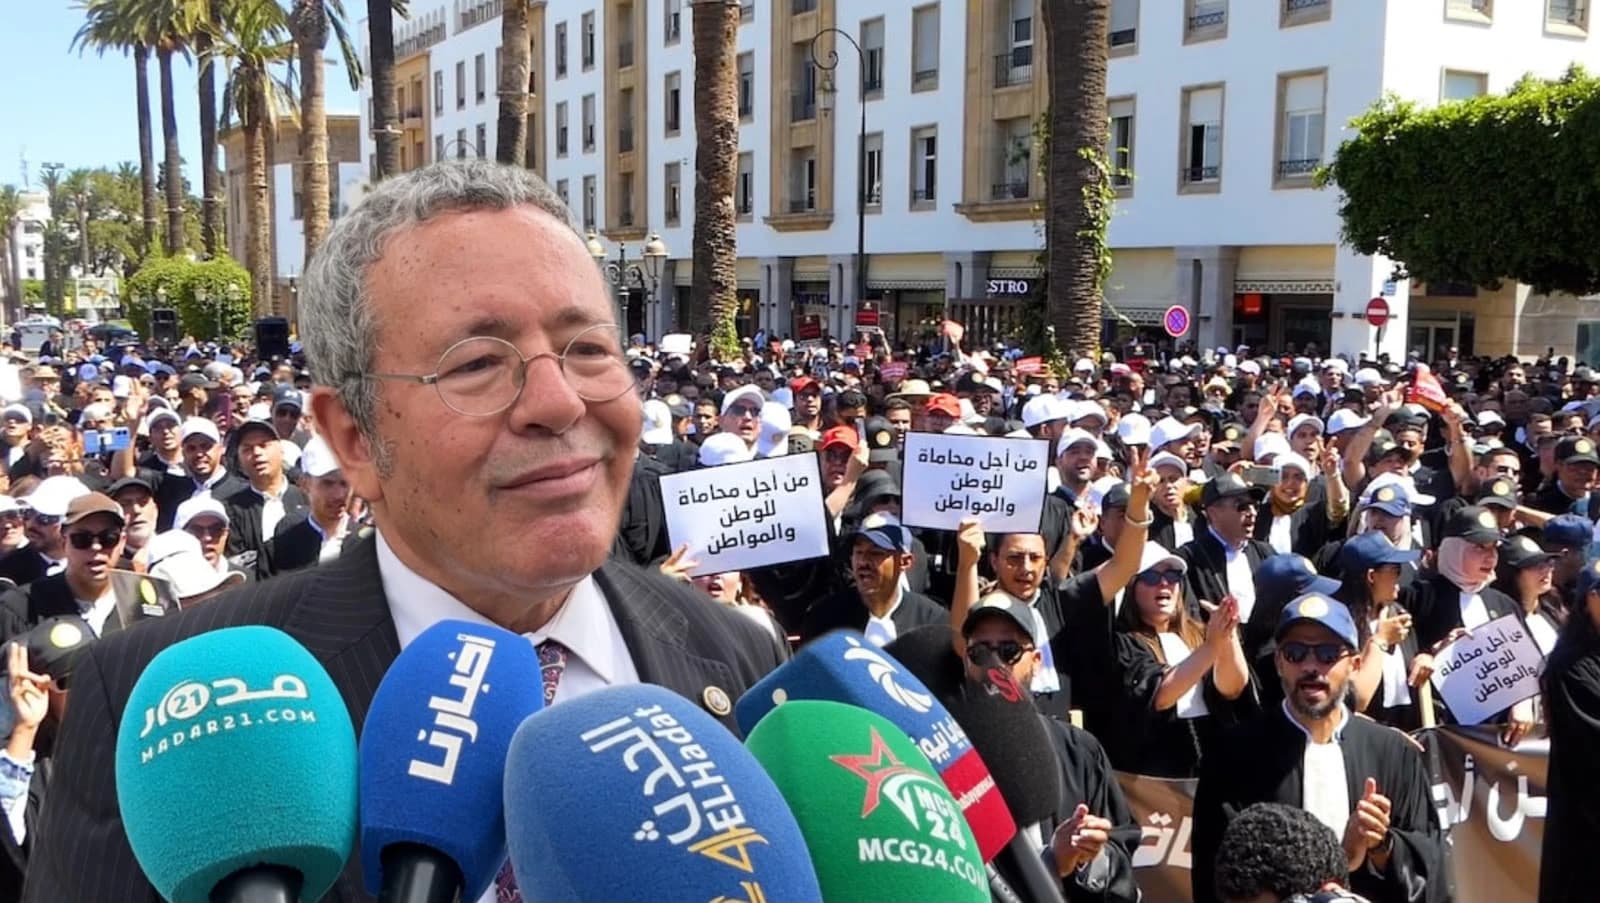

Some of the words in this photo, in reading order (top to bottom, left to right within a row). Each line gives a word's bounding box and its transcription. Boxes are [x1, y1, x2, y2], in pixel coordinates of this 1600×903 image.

[918, 447, 974, 467] محاماة
[1014, 453, 1038, 472] من
[678, 483, 740, 506] محاماة
[783, 472, 809, 493] من
[951, 472, 1003, 493] للوطن
[719, 499, 777, 528] للوطن
[935, 493, 1016, 517] والمواطن
[707, 522, 796, 555] والمواطن
[1475, 648, 1516, 680] للوطن
[141, 709, 317, 764] MADAR21.COM
[579, 715, 702, 845] الحدث
